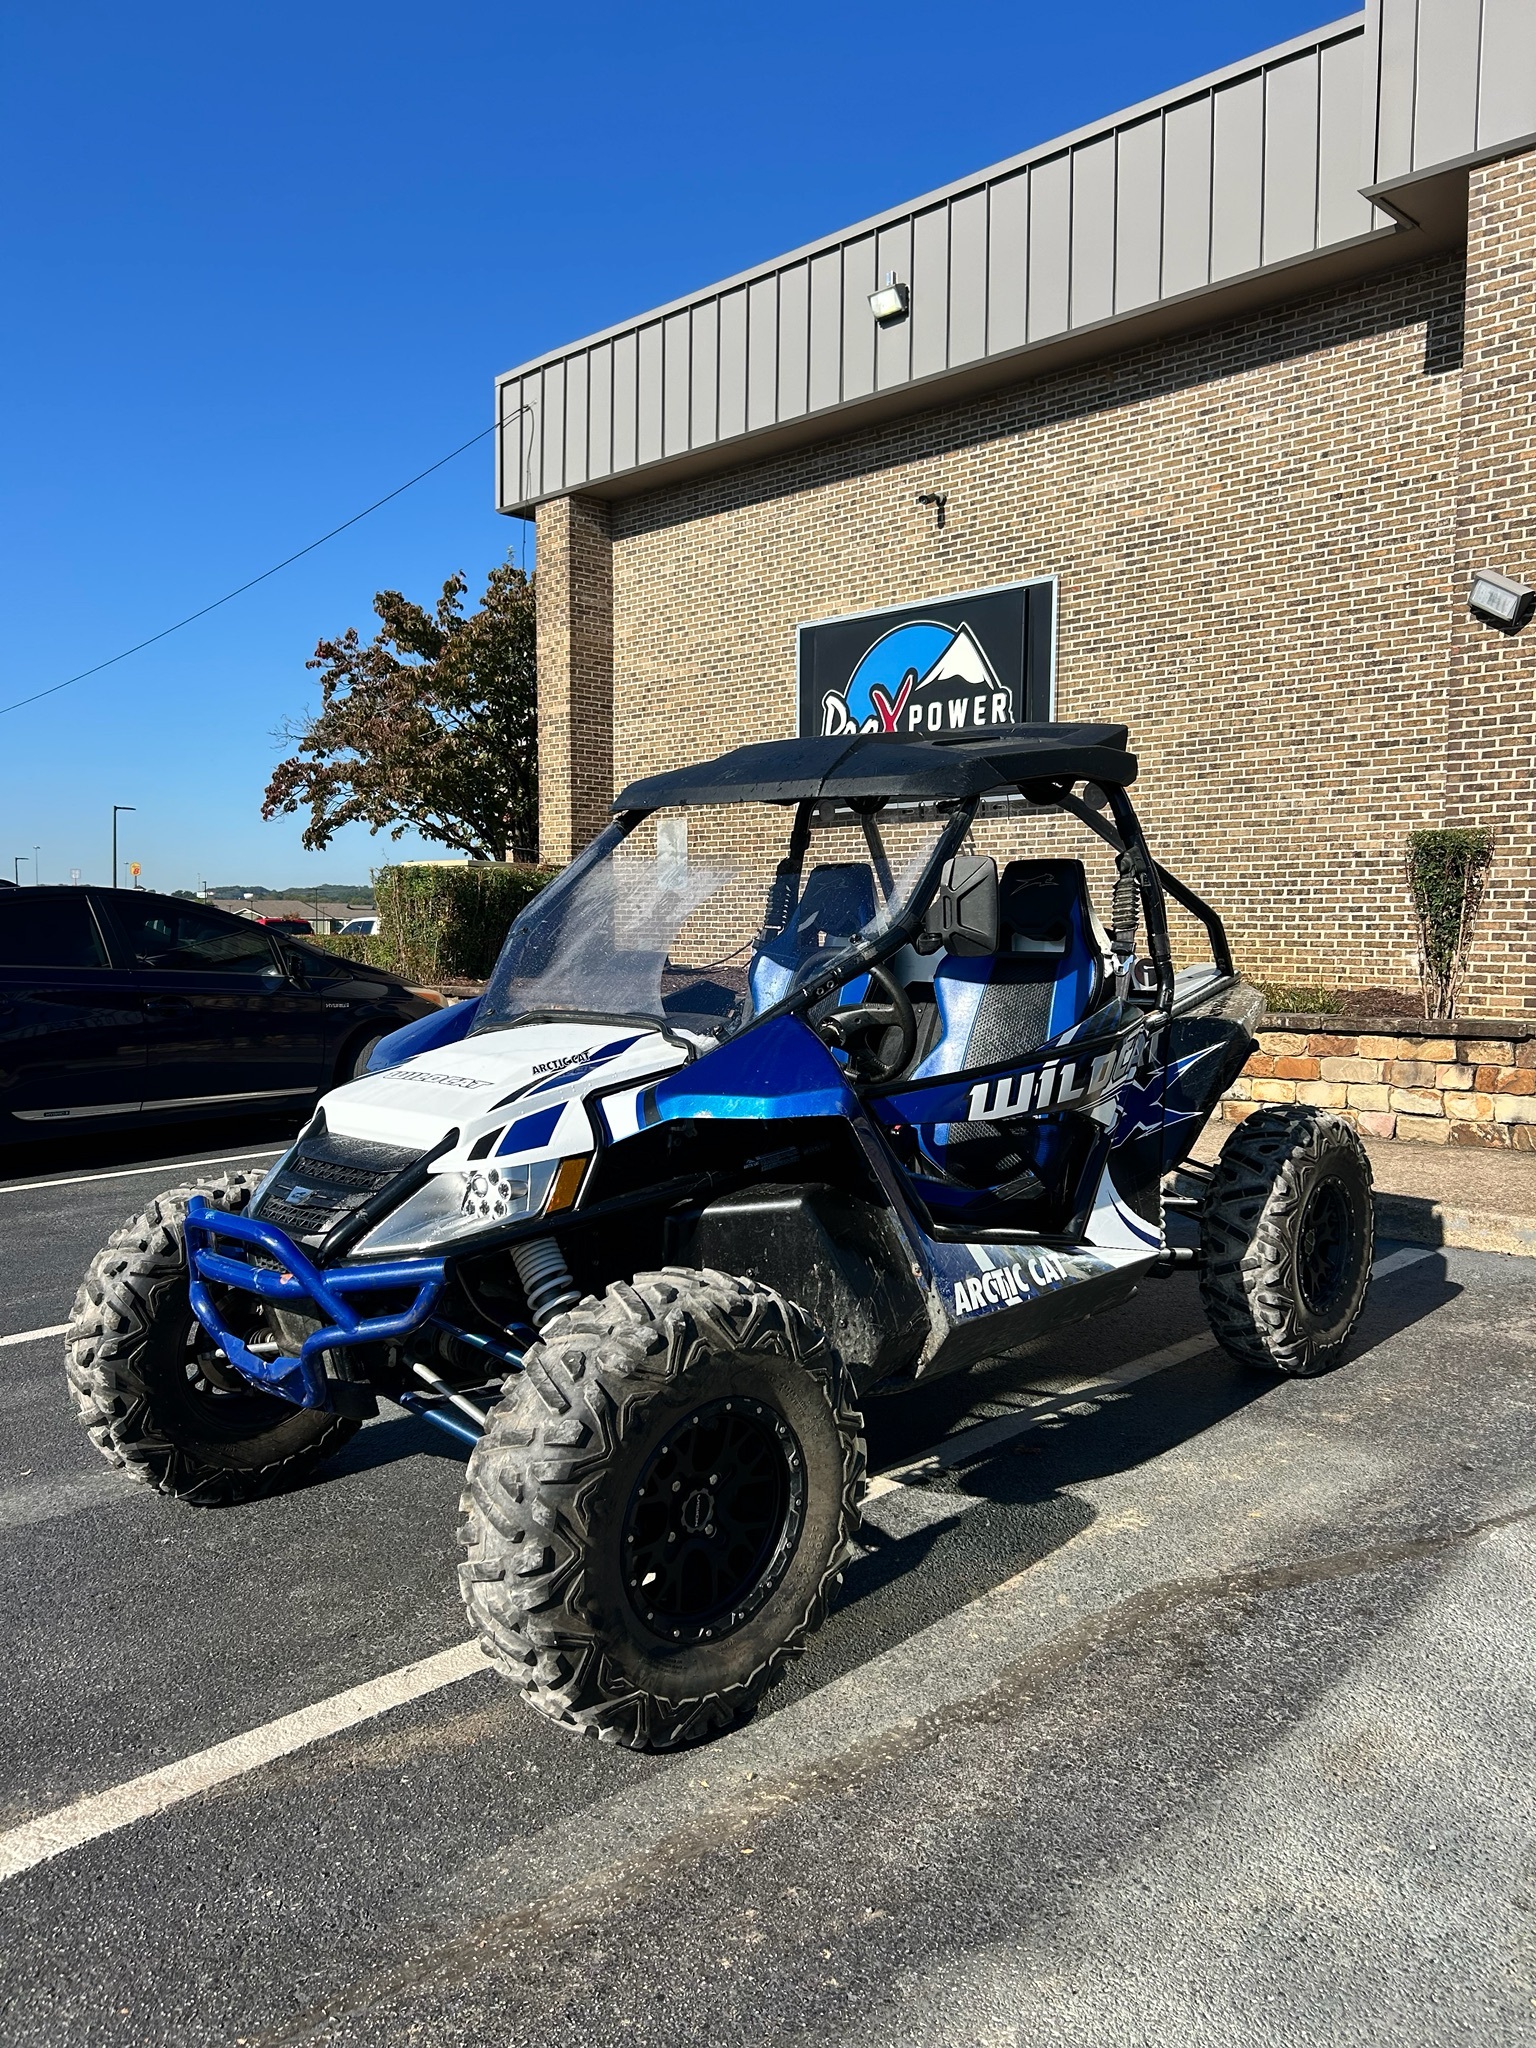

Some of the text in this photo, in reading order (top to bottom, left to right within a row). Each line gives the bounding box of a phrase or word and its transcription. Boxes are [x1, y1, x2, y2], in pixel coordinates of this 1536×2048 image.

[908, 692, 1007, 732] POWER
[532, 1052, 590, 1075] ARCTIC CAT
[953, 1252, 1068, 1317] ARCTIC CAT
